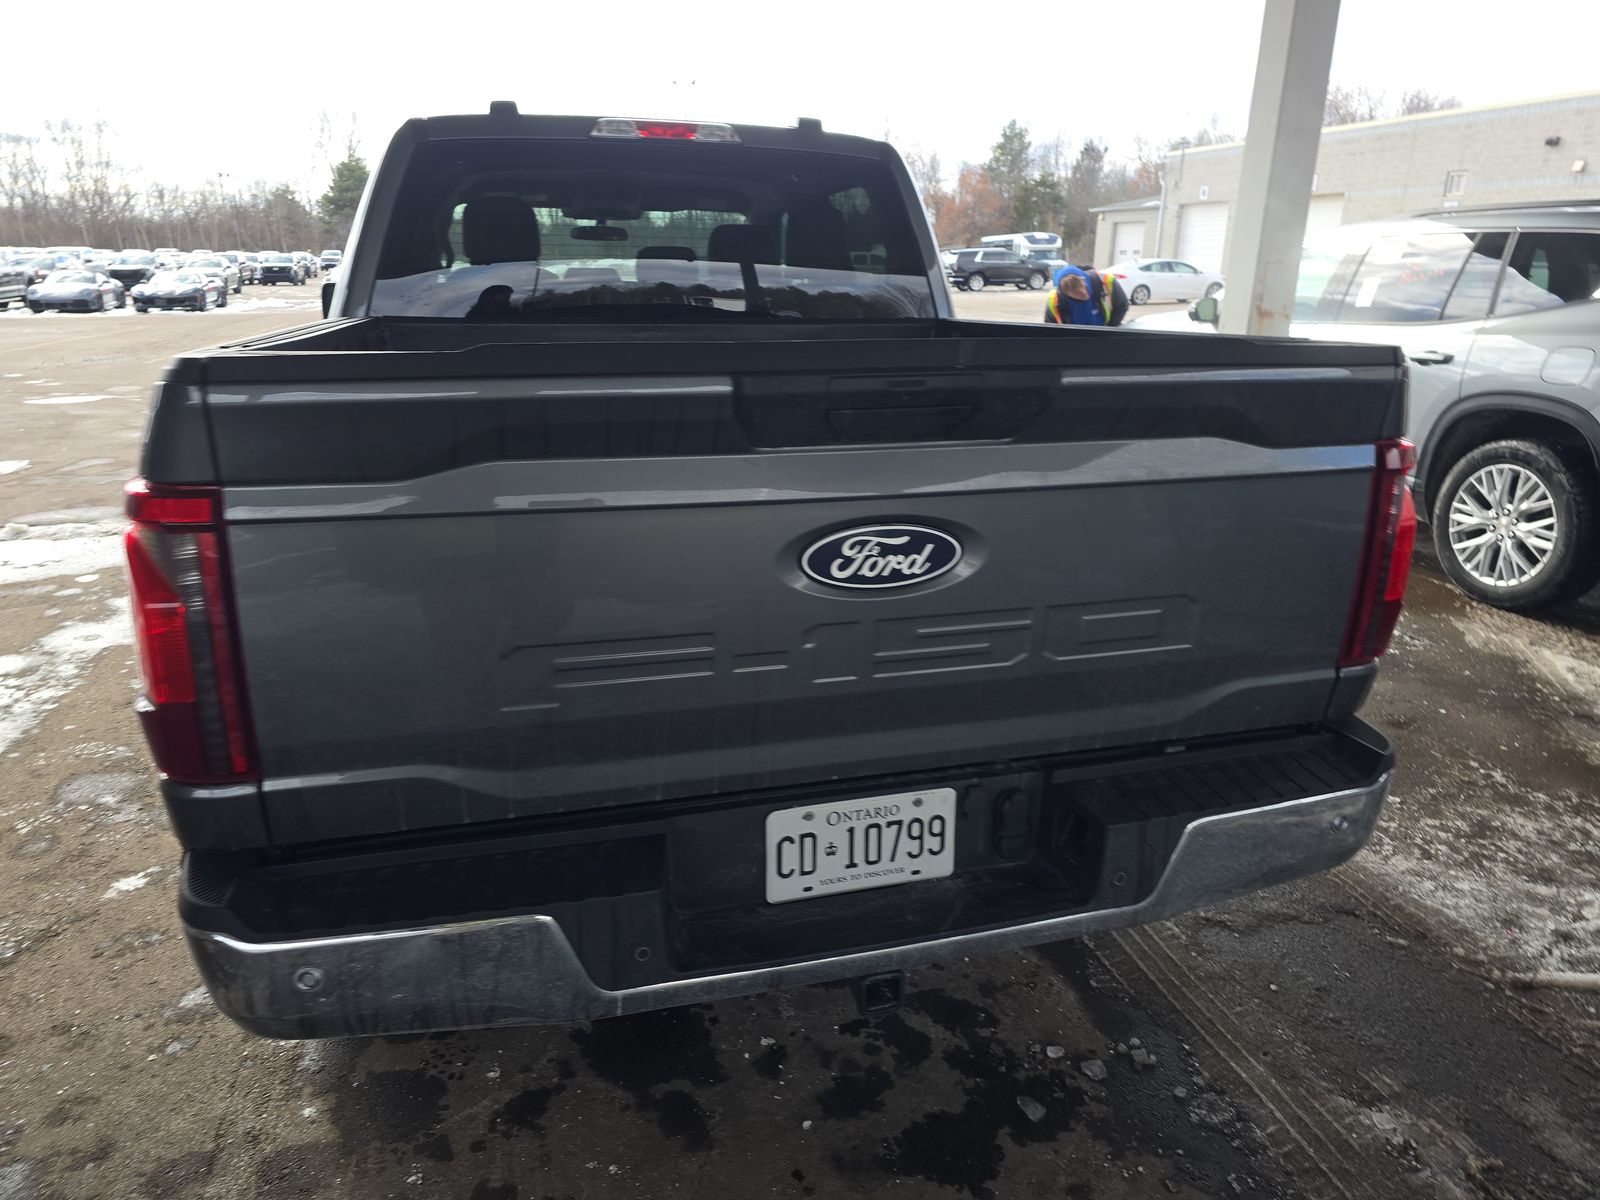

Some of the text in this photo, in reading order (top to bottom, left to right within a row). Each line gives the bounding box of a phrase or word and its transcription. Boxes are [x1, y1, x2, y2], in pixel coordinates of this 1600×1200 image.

[830, 535, 935, 579] Ford
[499, 593, 1200, 711] F-150
[826, 804, 900, 826] ONTARIO
[776, 814, 946, 879] CD 10799
[819, 867, 906, 886] YOURS TO DISCOVER
